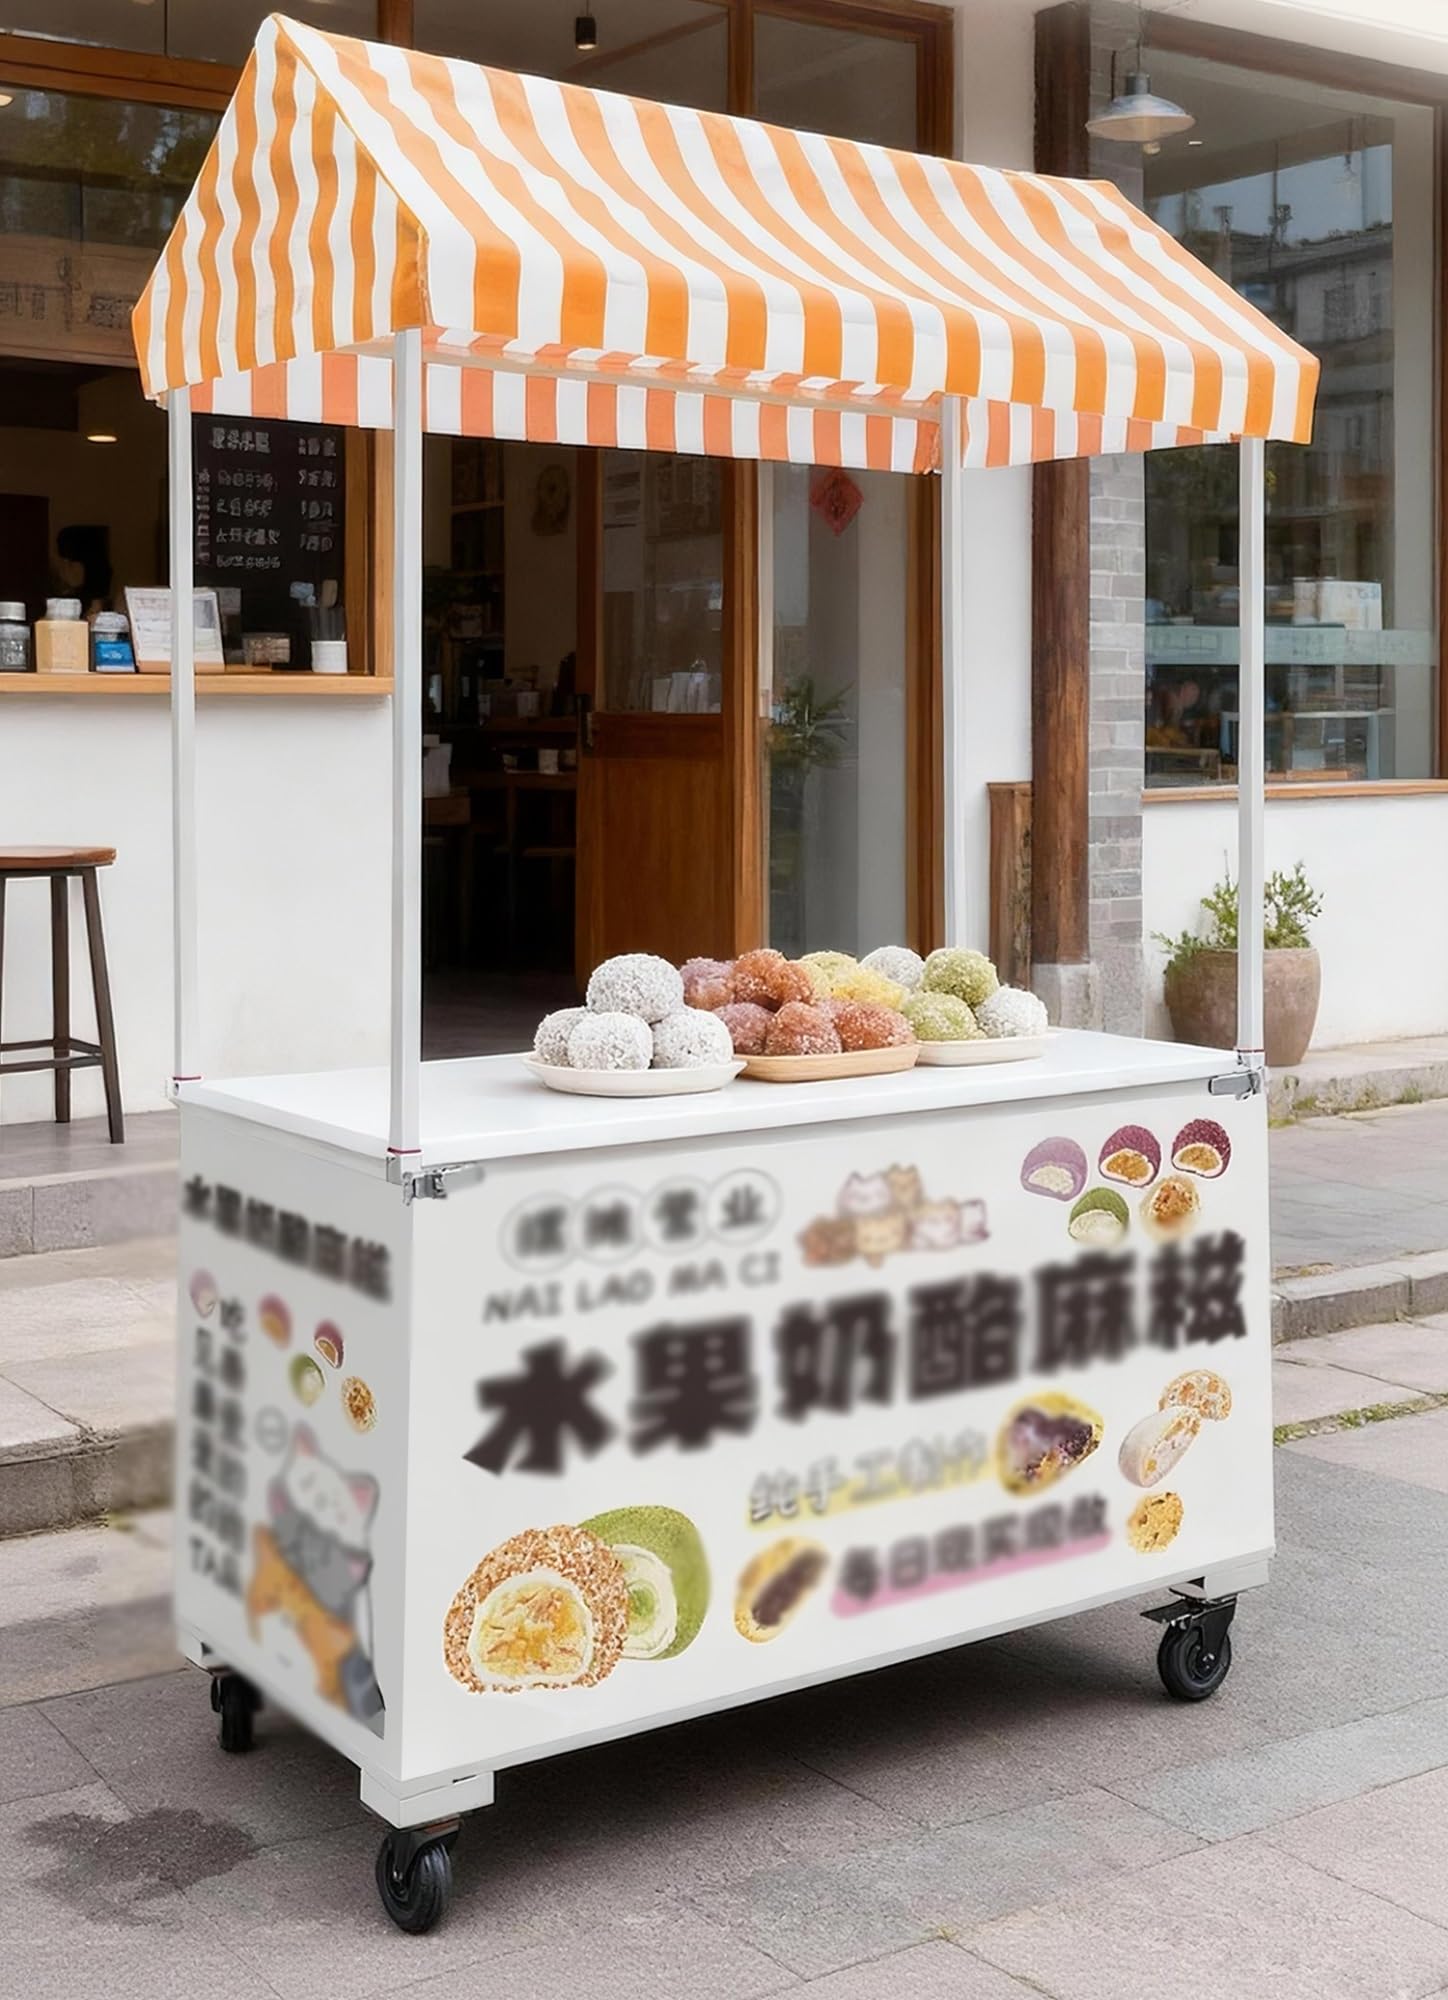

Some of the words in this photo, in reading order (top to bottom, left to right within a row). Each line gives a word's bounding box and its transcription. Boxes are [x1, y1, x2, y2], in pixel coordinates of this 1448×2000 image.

[483, 1281, 563, 1324] NAI
[575, 1268, 654, 1313] LAO
[669, 1259, 726, 1297] MA
[738, 1250, 780, 1287] CI
